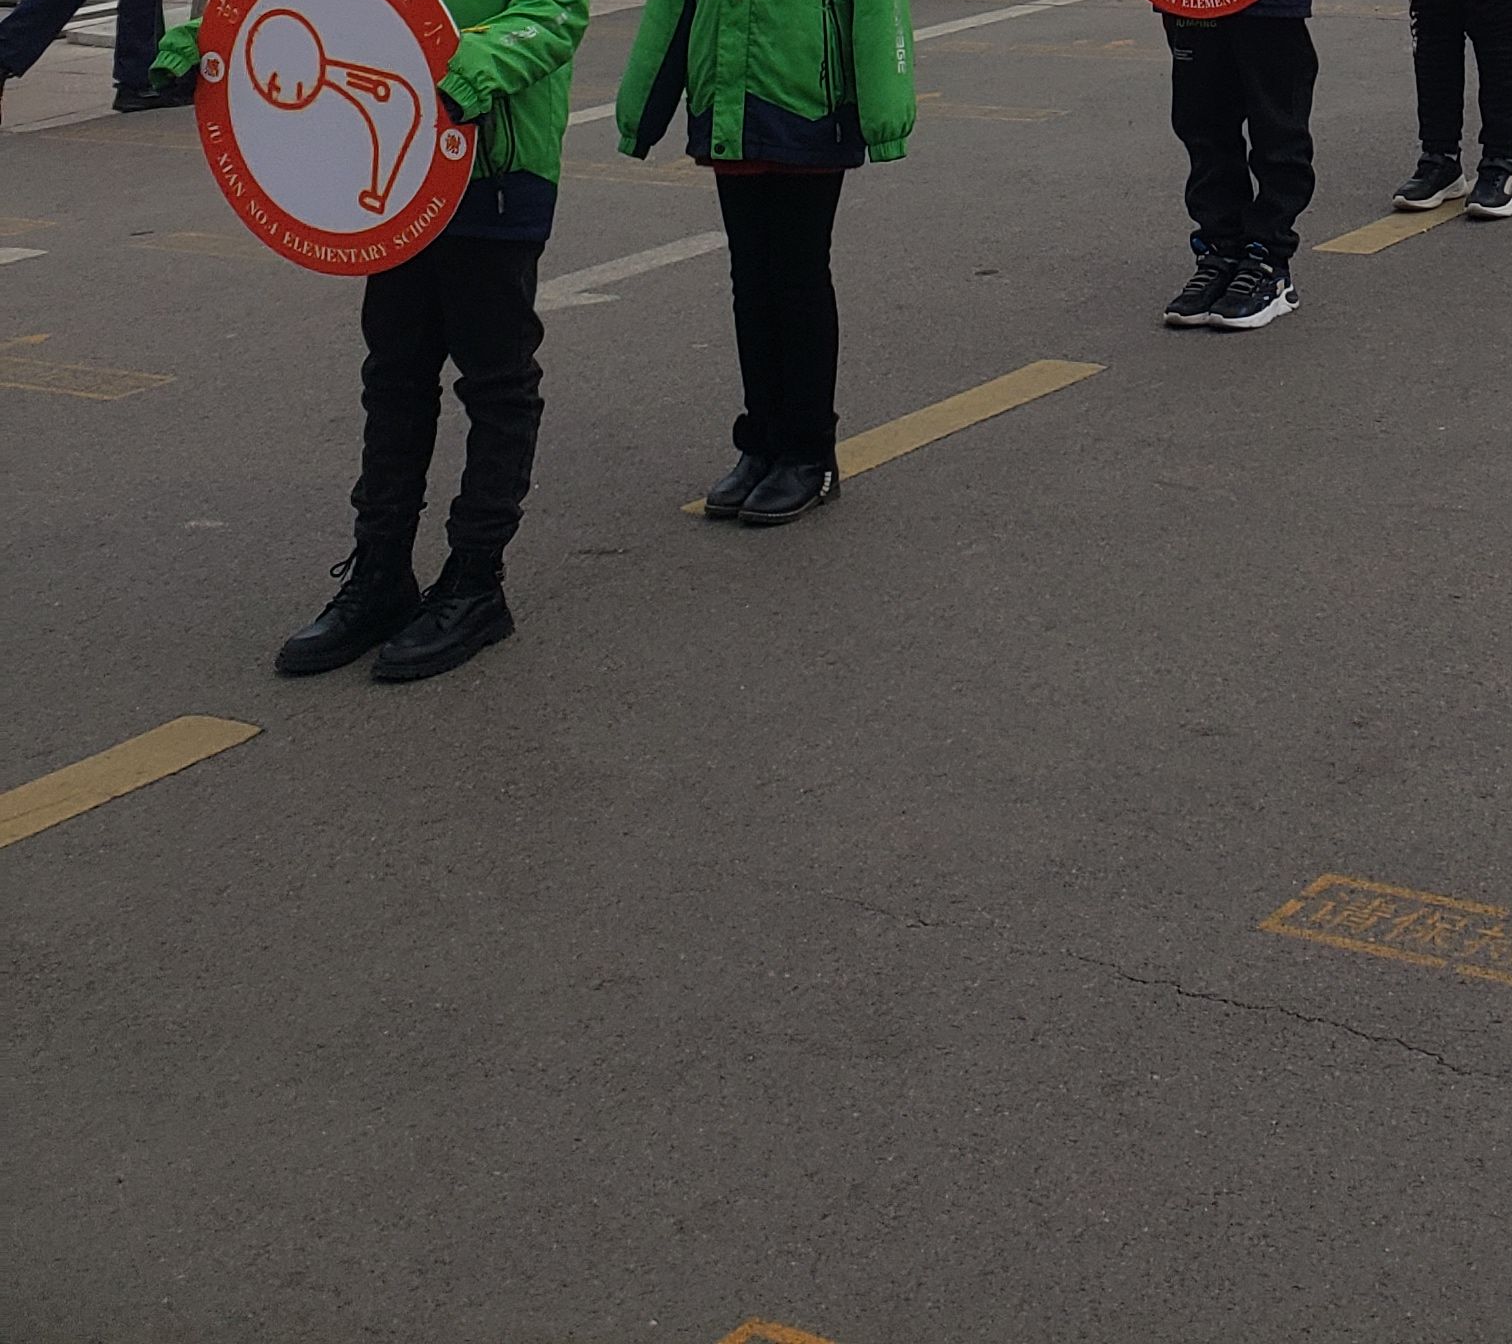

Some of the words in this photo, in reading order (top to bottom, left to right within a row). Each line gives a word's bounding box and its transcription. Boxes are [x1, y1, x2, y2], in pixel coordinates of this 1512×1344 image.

[217, 153, 246, 197] XIAN
[283, 231, 387, 263] ELEMENTARY
[392, 196, 447, 249] SCHOOL
